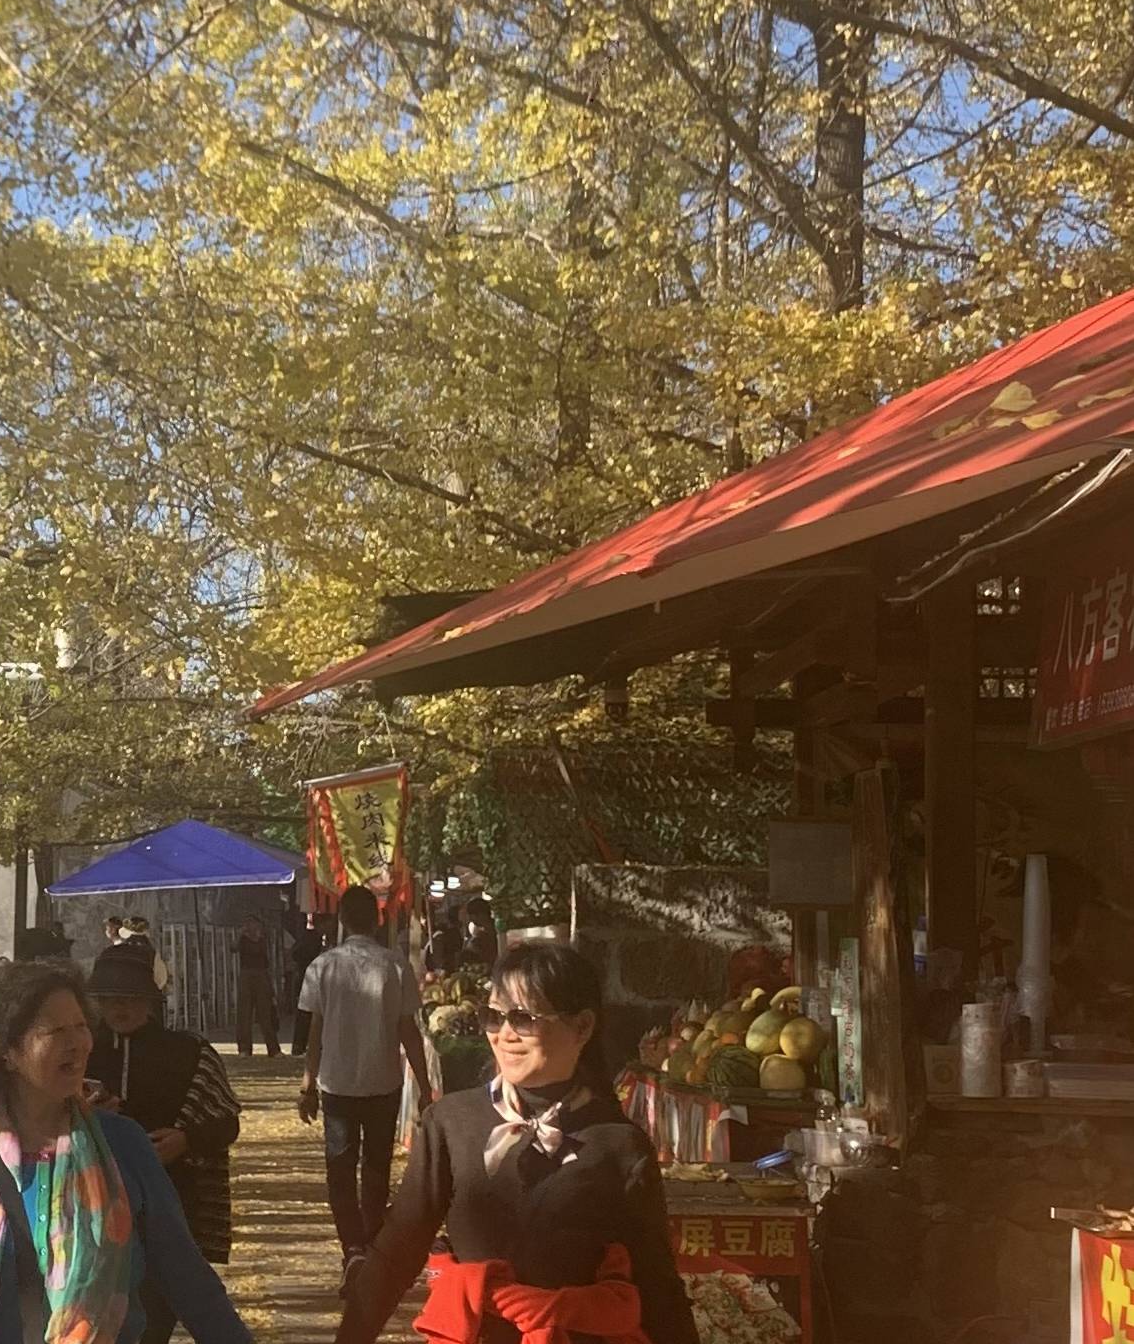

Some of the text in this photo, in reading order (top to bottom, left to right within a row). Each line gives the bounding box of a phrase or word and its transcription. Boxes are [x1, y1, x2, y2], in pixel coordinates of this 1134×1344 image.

[1052, 565, 1134, 675] 八方客
[670, 1218, 797, 1258] 屏豆腐
